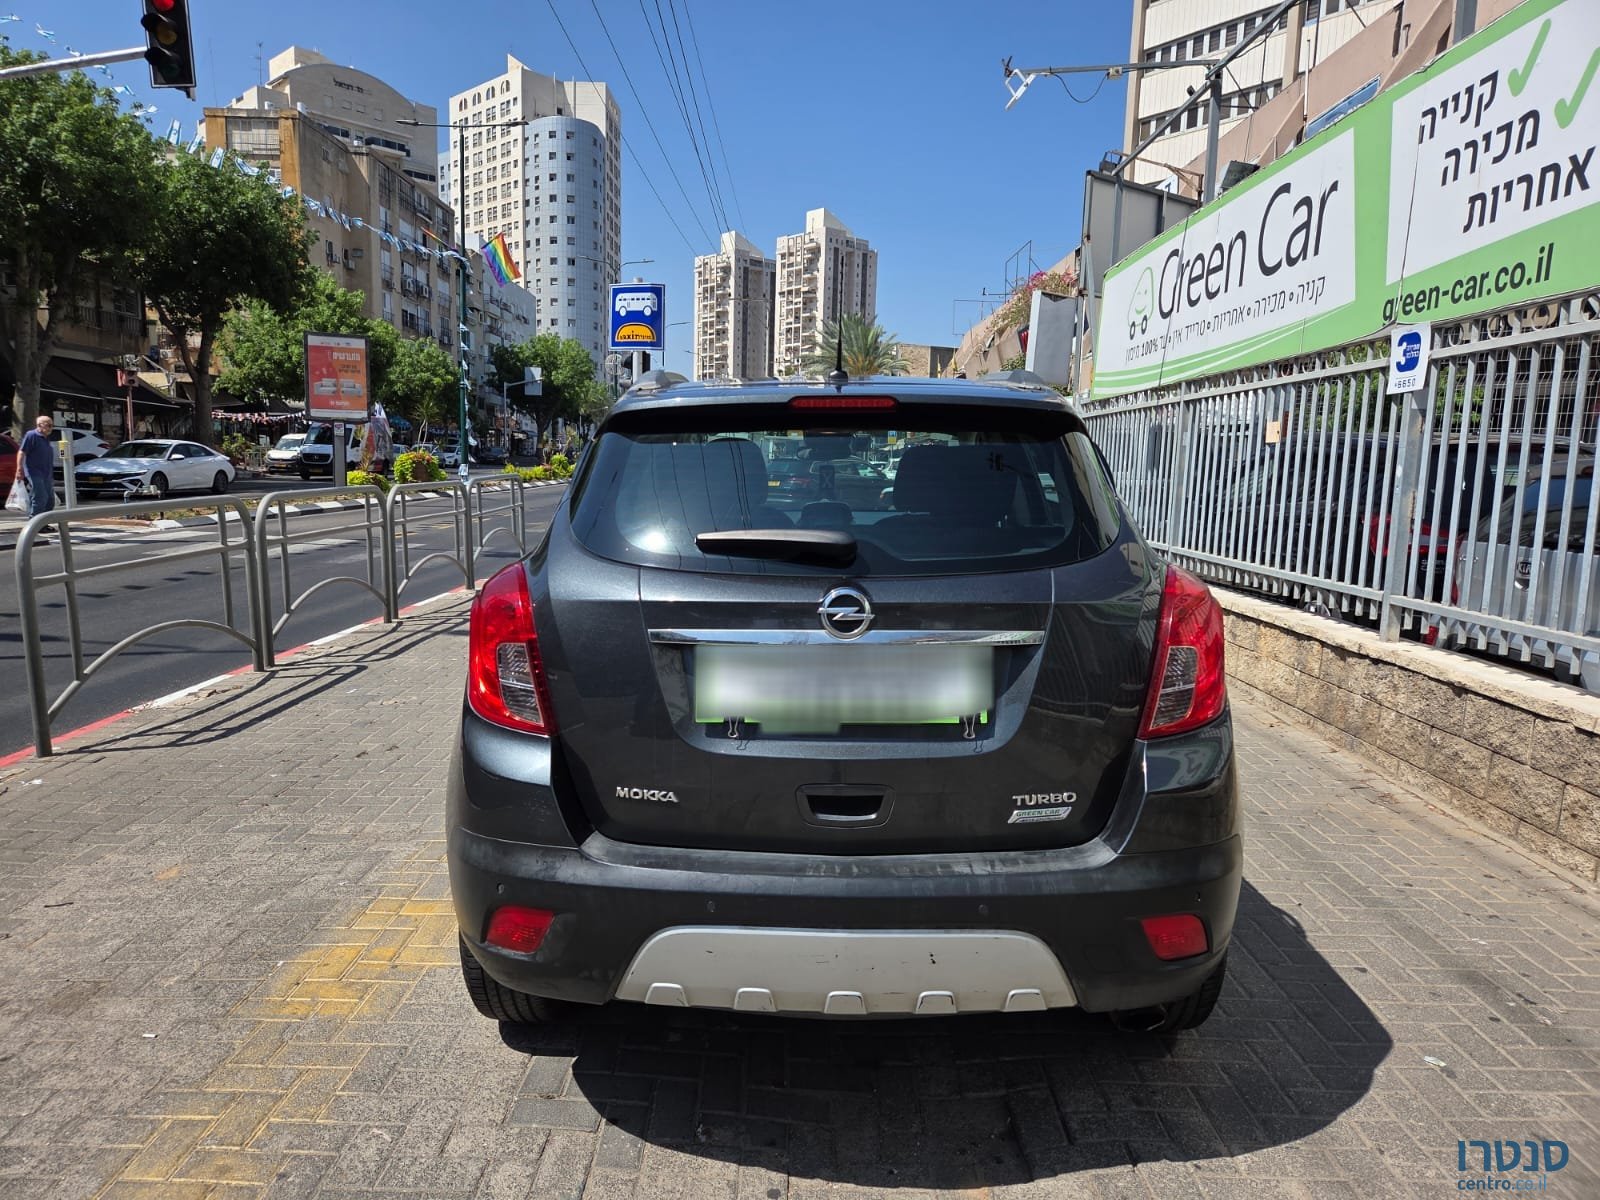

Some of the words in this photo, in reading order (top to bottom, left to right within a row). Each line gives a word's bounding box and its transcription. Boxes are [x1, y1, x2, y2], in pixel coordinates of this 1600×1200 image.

[1418, 69, 1499, 144] קנייה
[1440, 108, 1541, 187] מכירה
[1462, 145, 1597, 234] אחריות
[1158, 229, 1247, 320] Green
[1257, 179, 1340, 277] Car
[1253, 290, 1286, 318] מכירה
[1296, 276, 1326, 305] קניה
[1212, 304, 1246, 332] אחריות
[615, 786, 679, 803] MOKKA
[1012, 791, 1077, 806] TURBO
